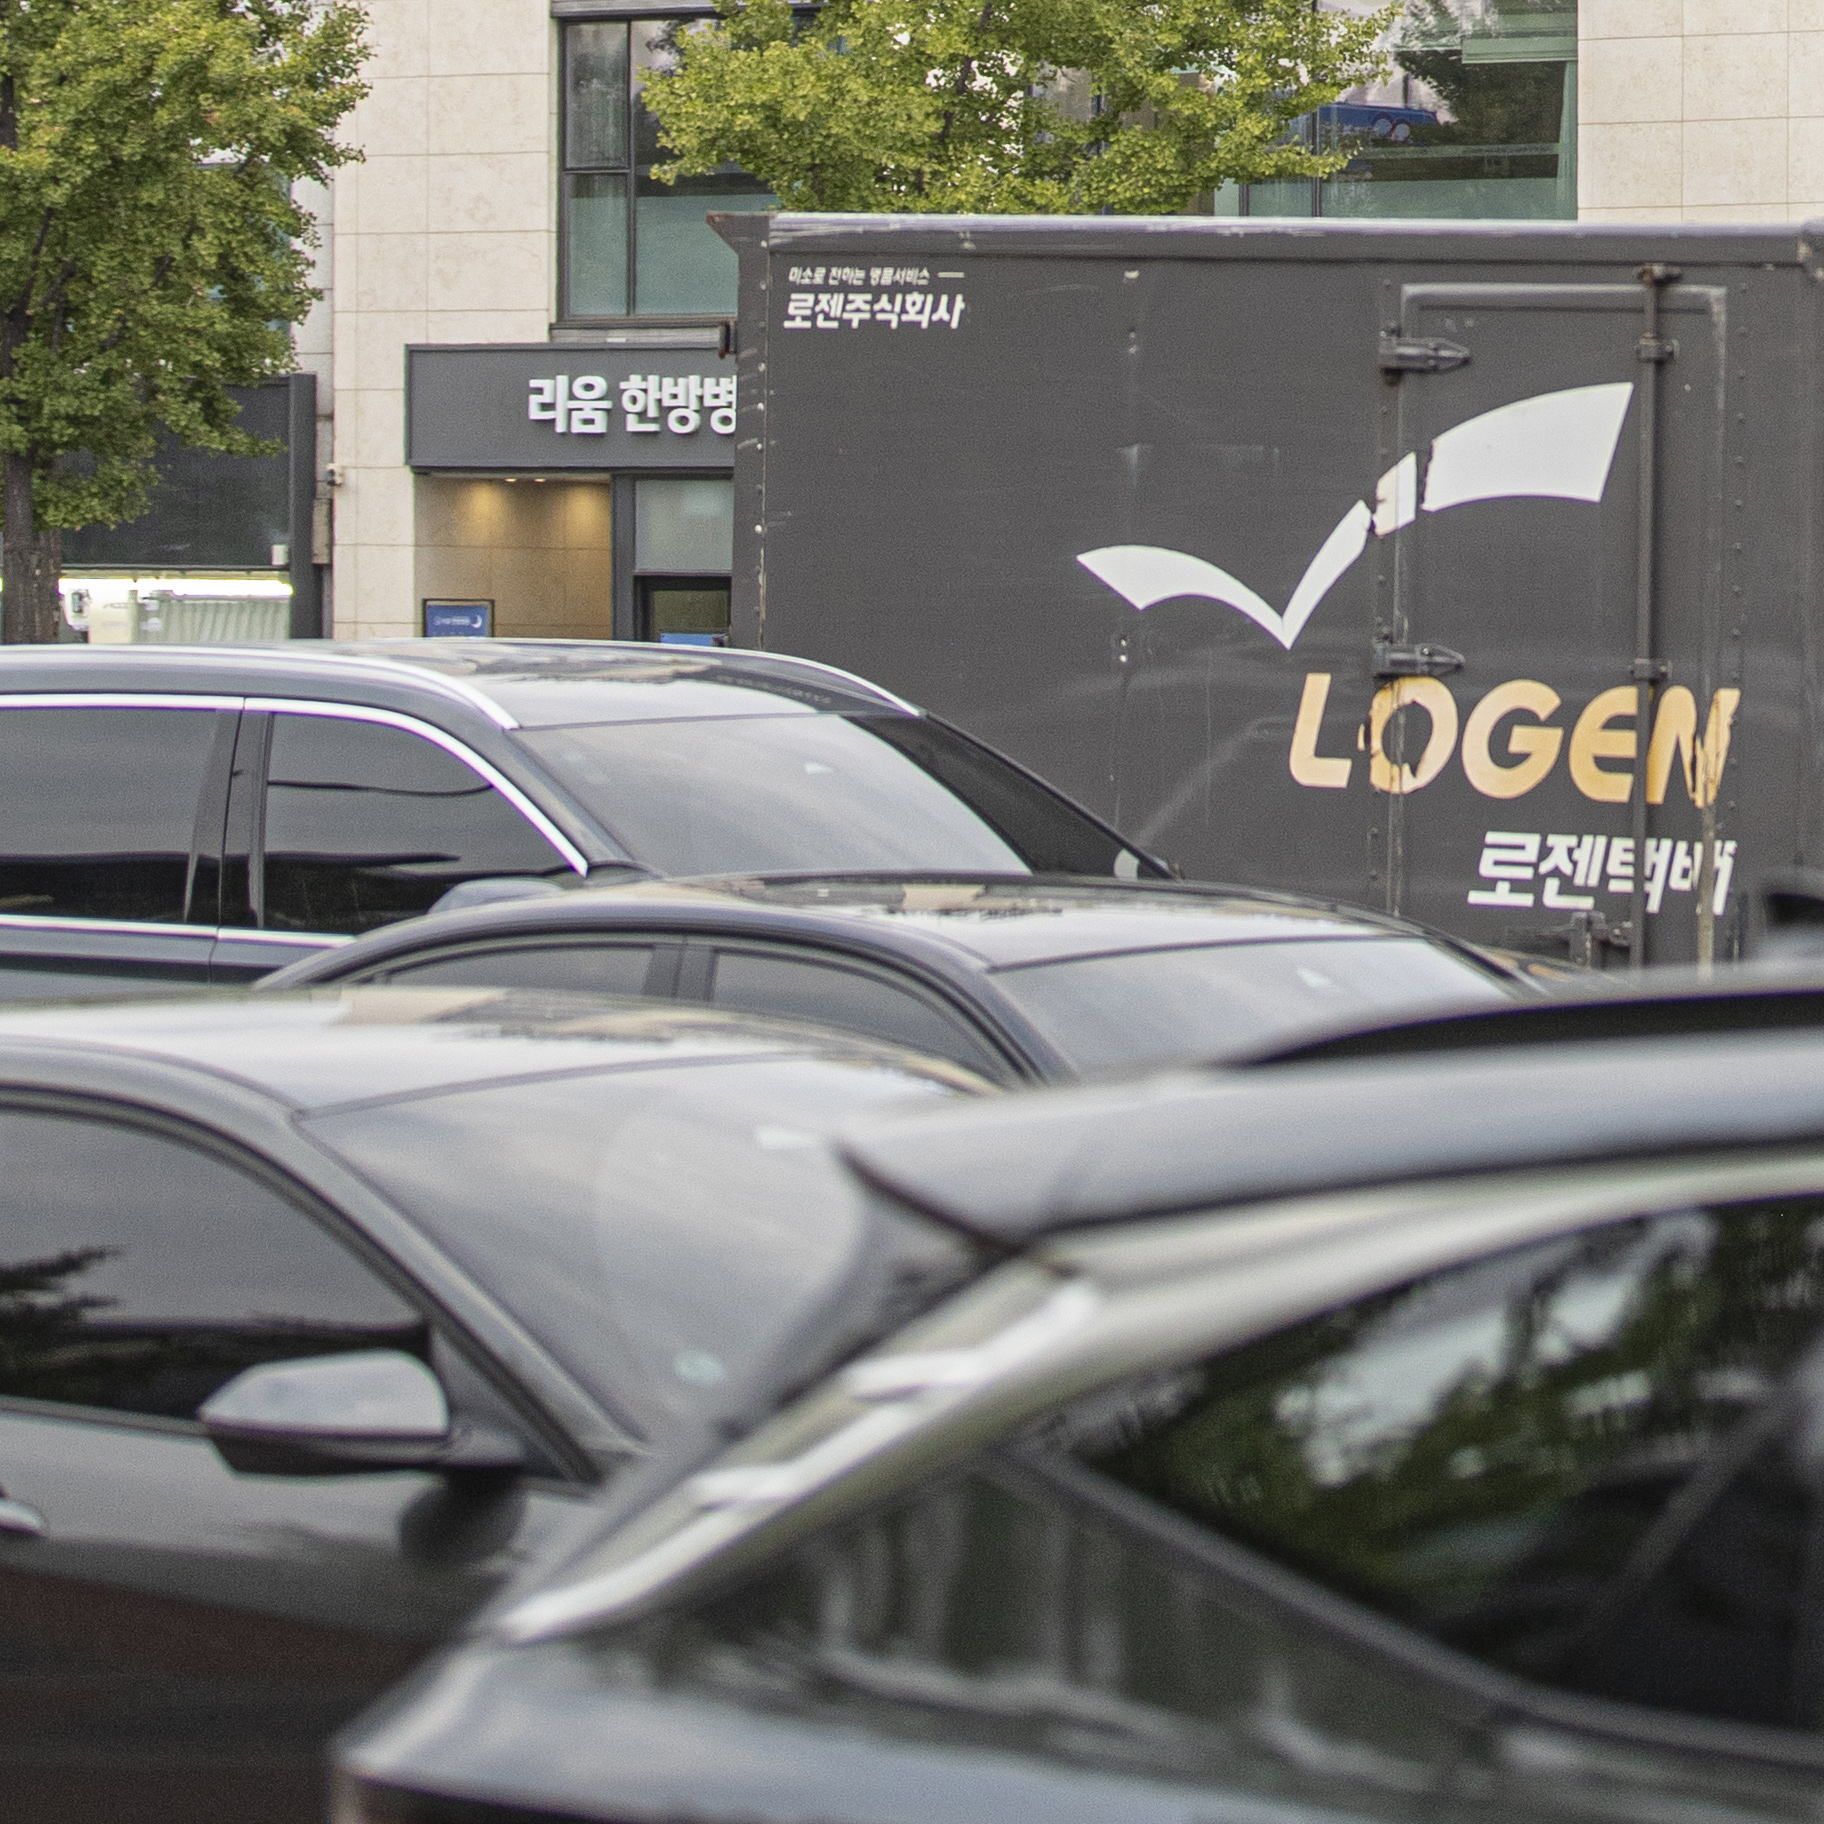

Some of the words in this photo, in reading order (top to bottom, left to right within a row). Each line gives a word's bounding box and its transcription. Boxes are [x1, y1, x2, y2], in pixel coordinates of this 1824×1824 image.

[788, 266, 826, 285] 미소로
[783, 291, 965, 330] 로젠주식회사
[528, 374, 613, 434] 리움
[1289, 672, 1741, 809] LOGEN
[1466, 830, 1738, 917] 로젠택배
